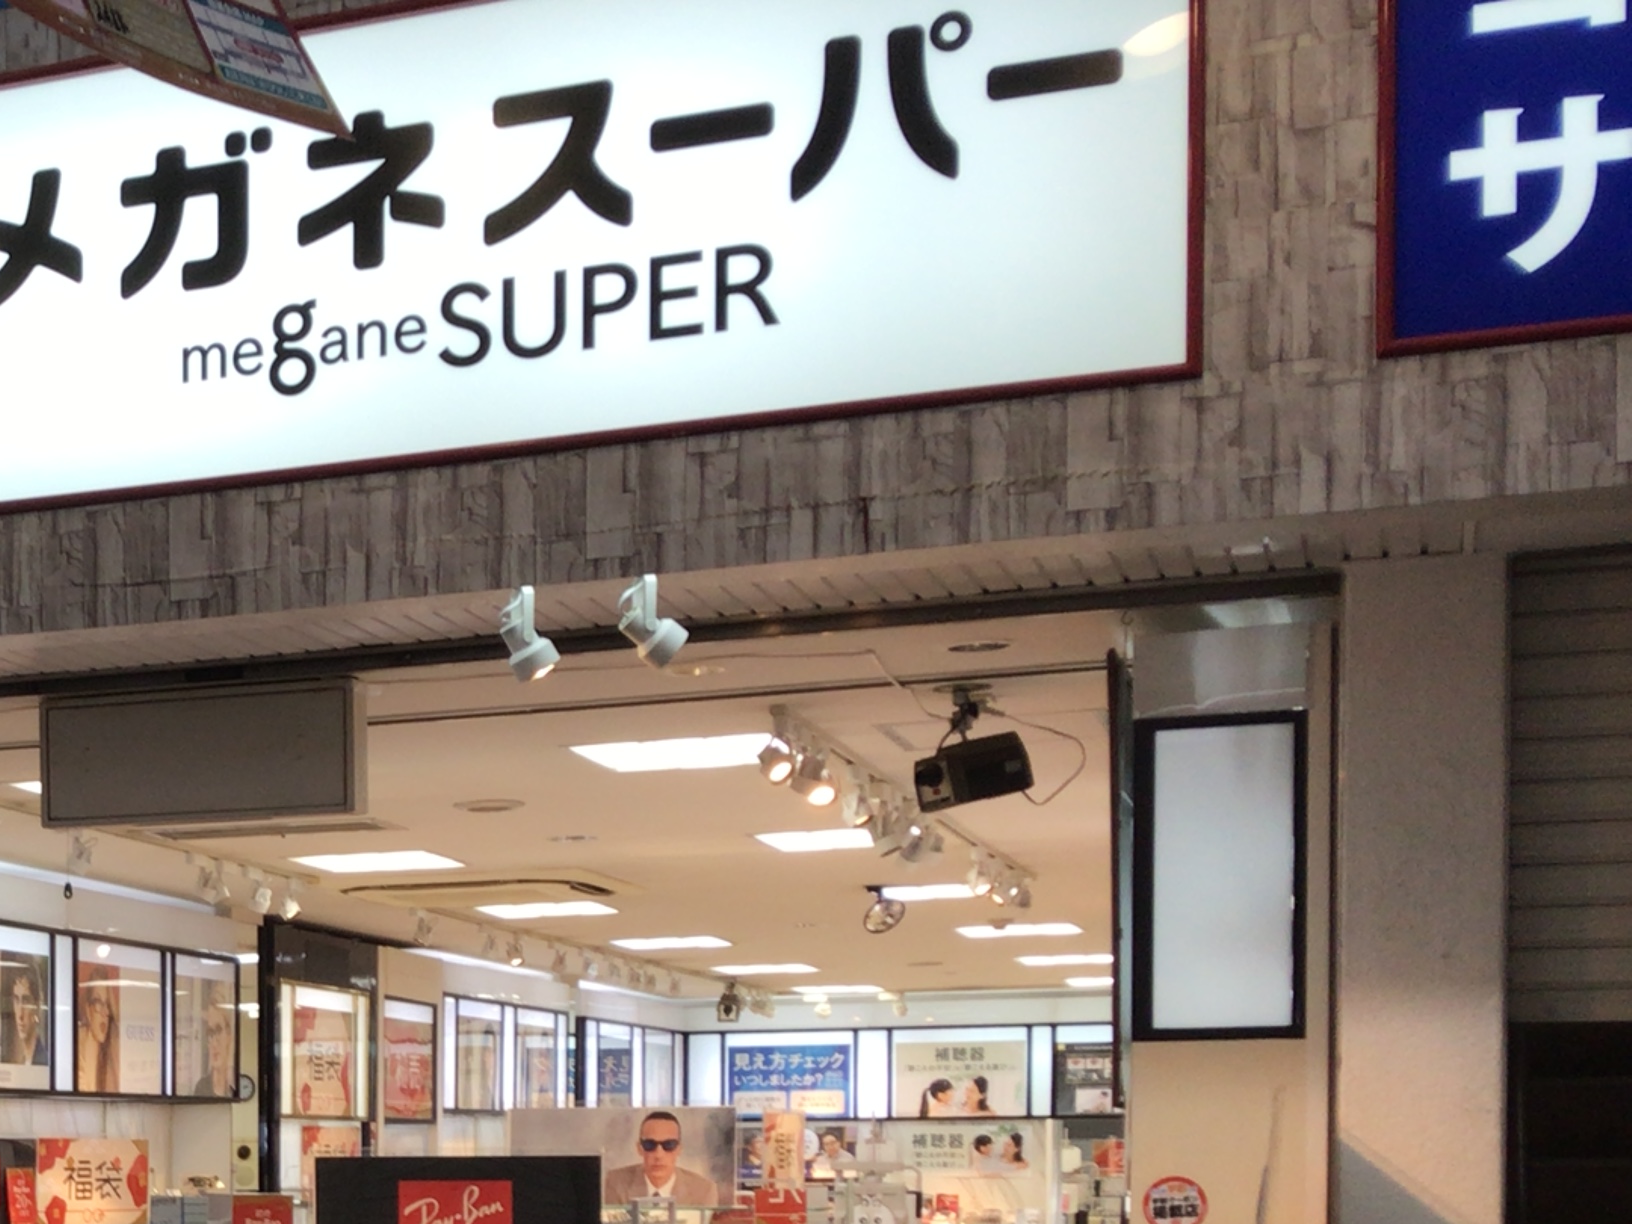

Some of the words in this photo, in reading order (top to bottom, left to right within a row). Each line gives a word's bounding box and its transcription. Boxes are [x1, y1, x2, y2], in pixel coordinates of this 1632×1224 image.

[733, 1051, 845, 1072] 見え方チェック
[63, 1159, 123, 1201] 福袋
